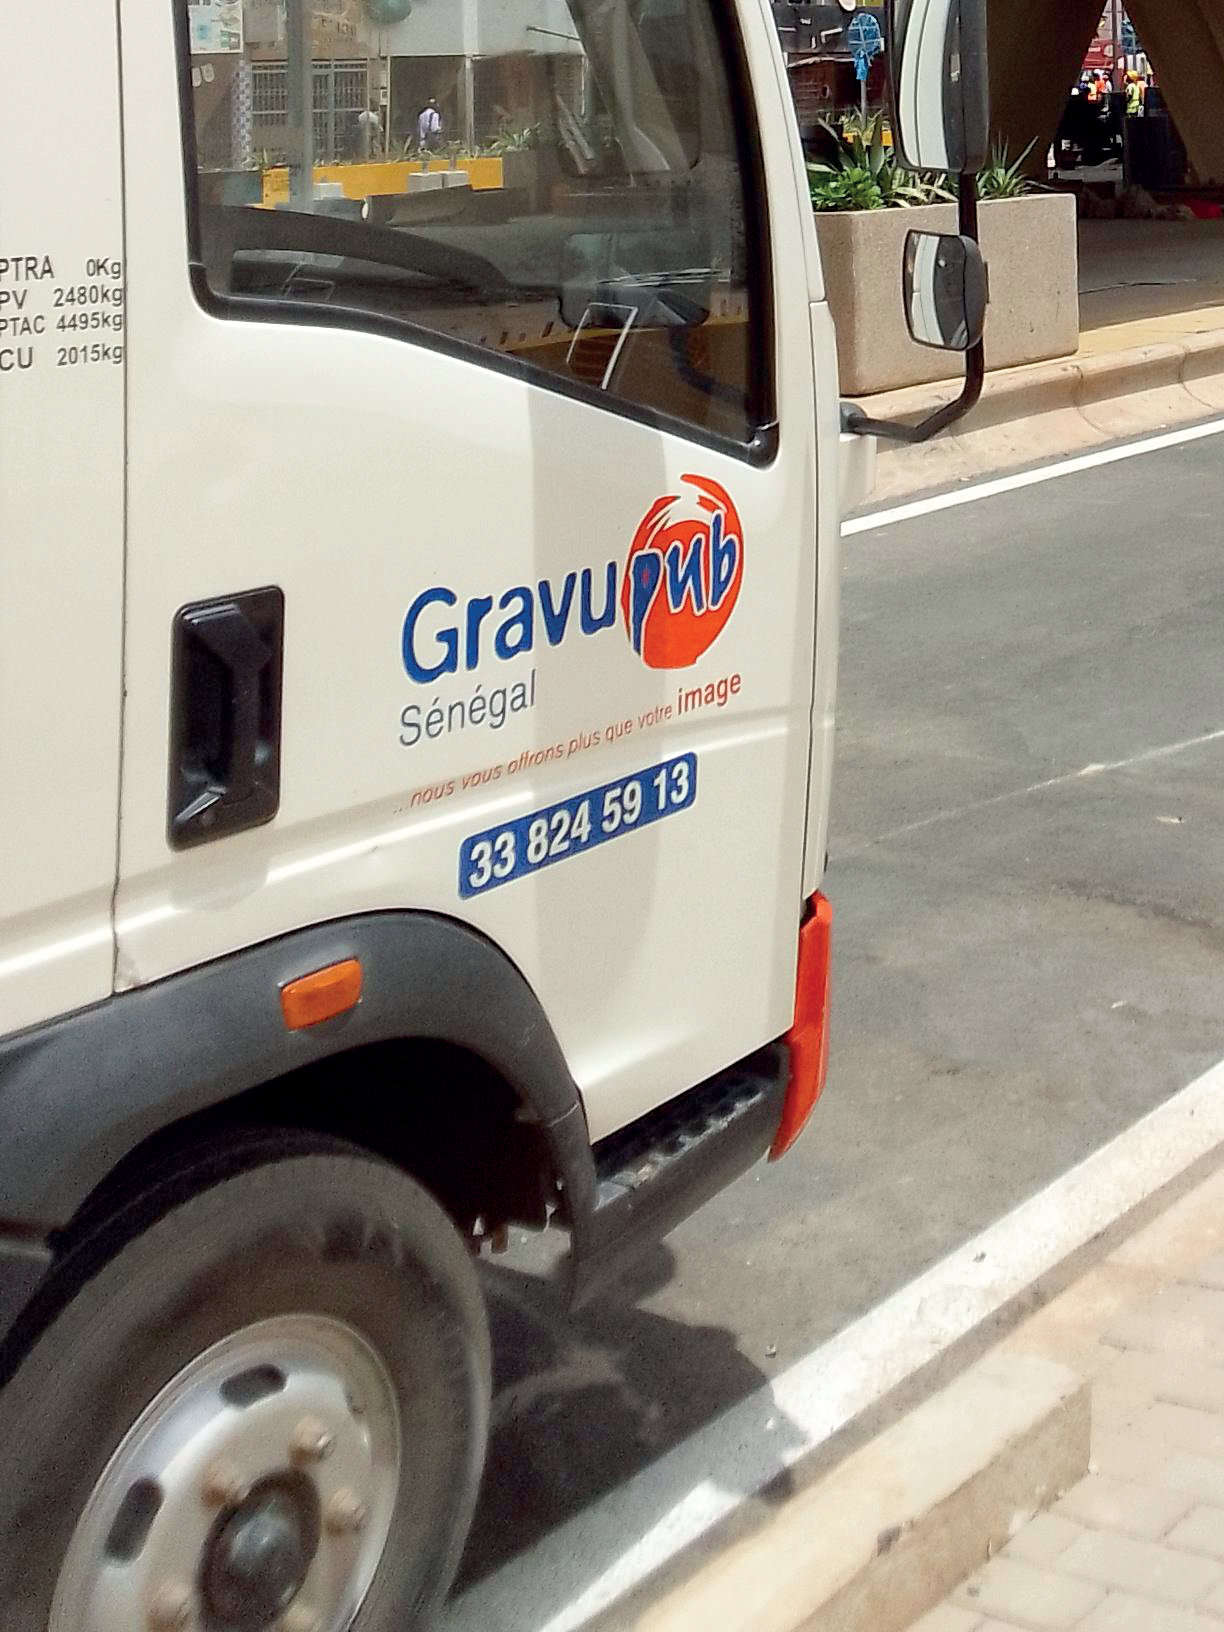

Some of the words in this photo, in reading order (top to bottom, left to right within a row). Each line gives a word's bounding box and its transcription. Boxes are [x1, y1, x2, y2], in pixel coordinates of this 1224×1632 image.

[0, 255, 54, 281] PTRA
[86, 258, 121, 279] 0Kg
[0, 289, 27, 310] PV
[53, 284, 124, 307] 2480kg
[0, 315, 45, 336] PTAC
[56, 311, 123, 331] 4495kg
[0, 347, 33, 371] CU
[57, 343, 123, 365] 2015kg
[399, 669, 535, 746] Sénégal
[462, 765, 503, 790] vous
[507, 743, 564, 775] offrons
[567, 729, 600, 758] plus
[605, 719, 632, 742] que
[638, 704, 672, 728] votre
[677, 673, 741, 715] image
[469, 831, 516, 888] 33
[527, 800, 592, 864] 824
[602, 780, 642, 833] 59
[653, 761, 689, 810] 13
